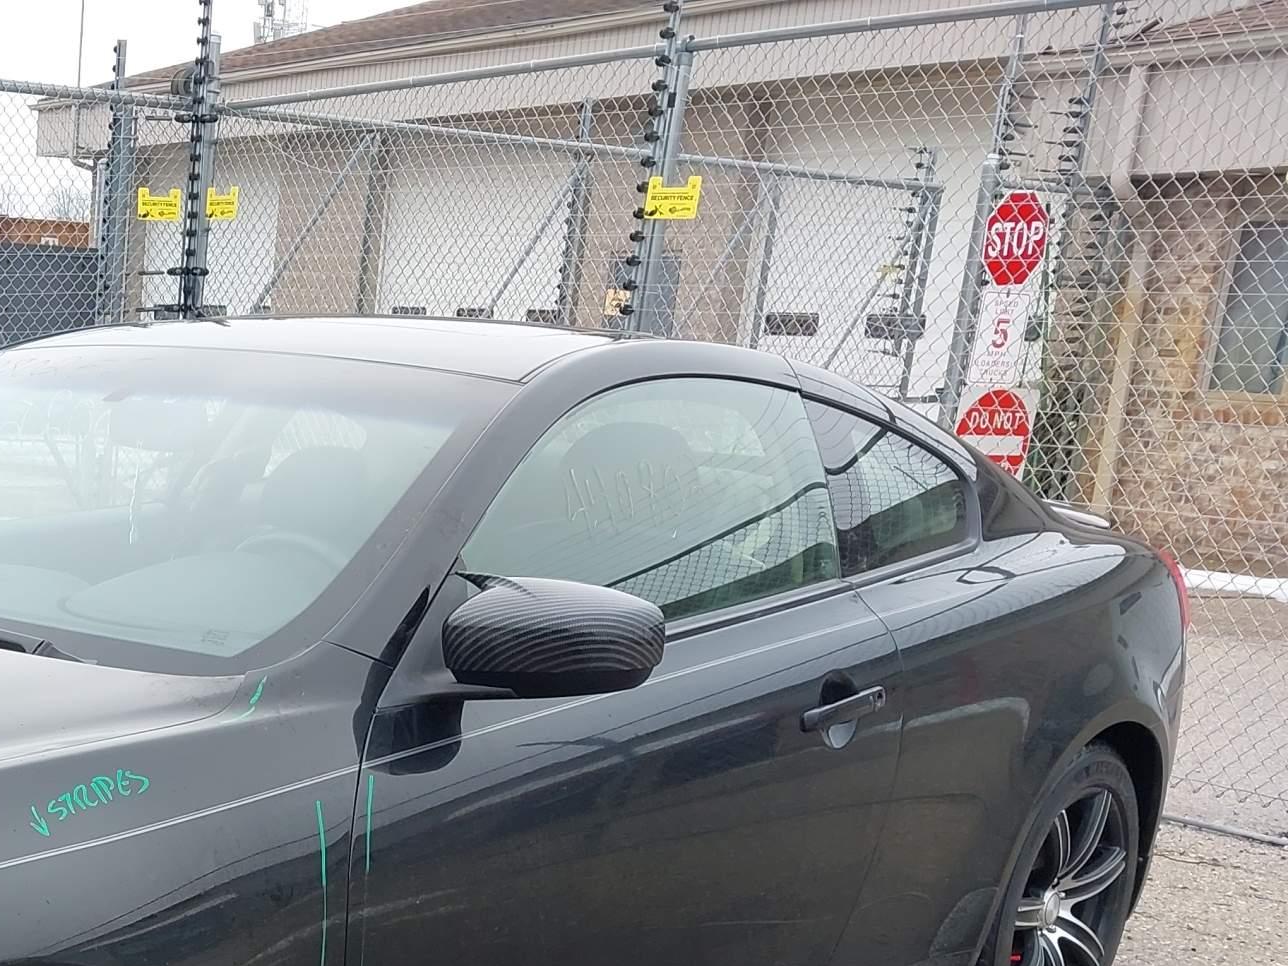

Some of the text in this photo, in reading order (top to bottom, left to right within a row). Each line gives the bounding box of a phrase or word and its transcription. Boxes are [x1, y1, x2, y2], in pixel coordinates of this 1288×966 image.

[988, 221, 1044, 257] STOP
[991, 318, 1011, 349] 5
[970, 411, 1022, 430] DO NOT
